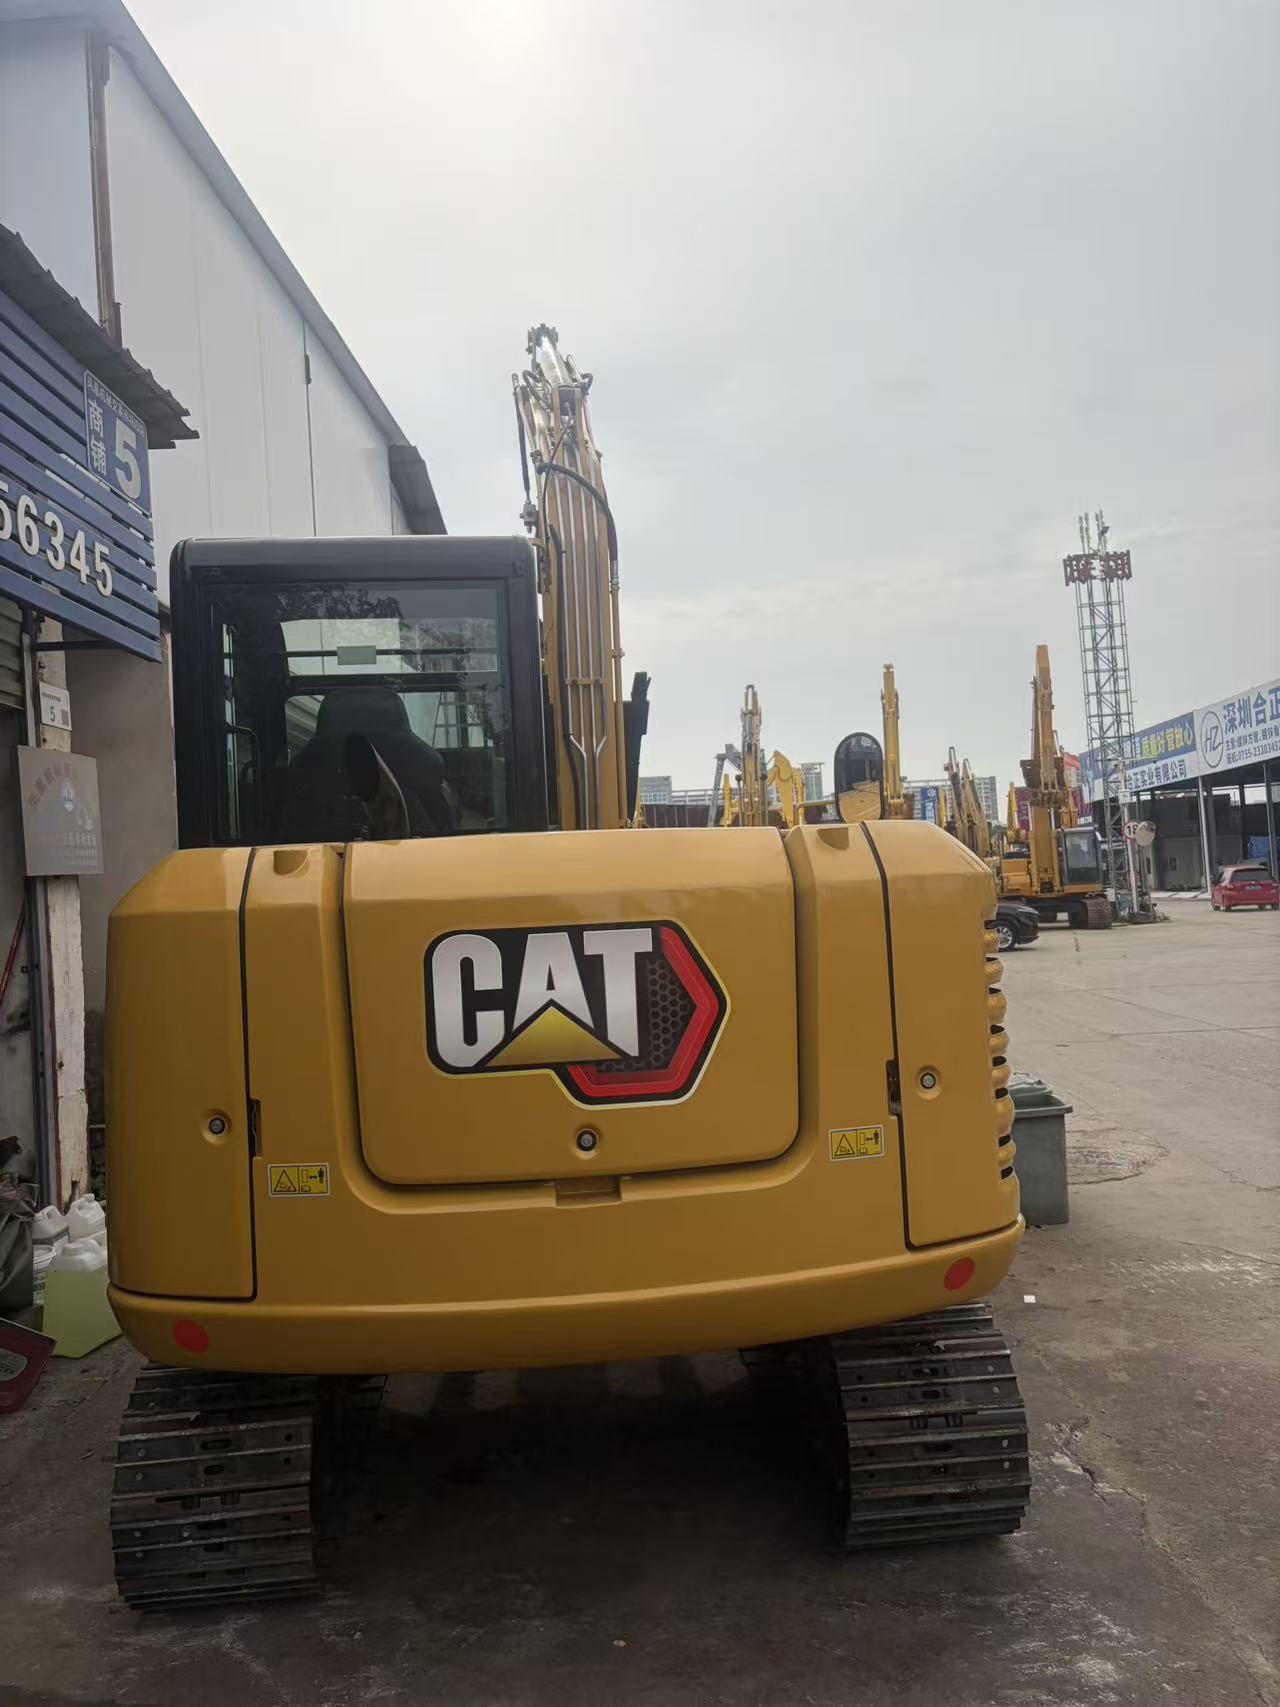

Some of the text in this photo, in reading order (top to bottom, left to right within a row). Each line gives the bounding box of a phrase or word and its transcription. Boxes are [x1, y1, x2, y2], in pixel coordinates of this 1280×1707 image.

[115, 417, 142, 499] 5
[0, 480, 113, 597] 56345
[49, 705, 56, 722] 5
[432, 928, 653, 1068] CAT
